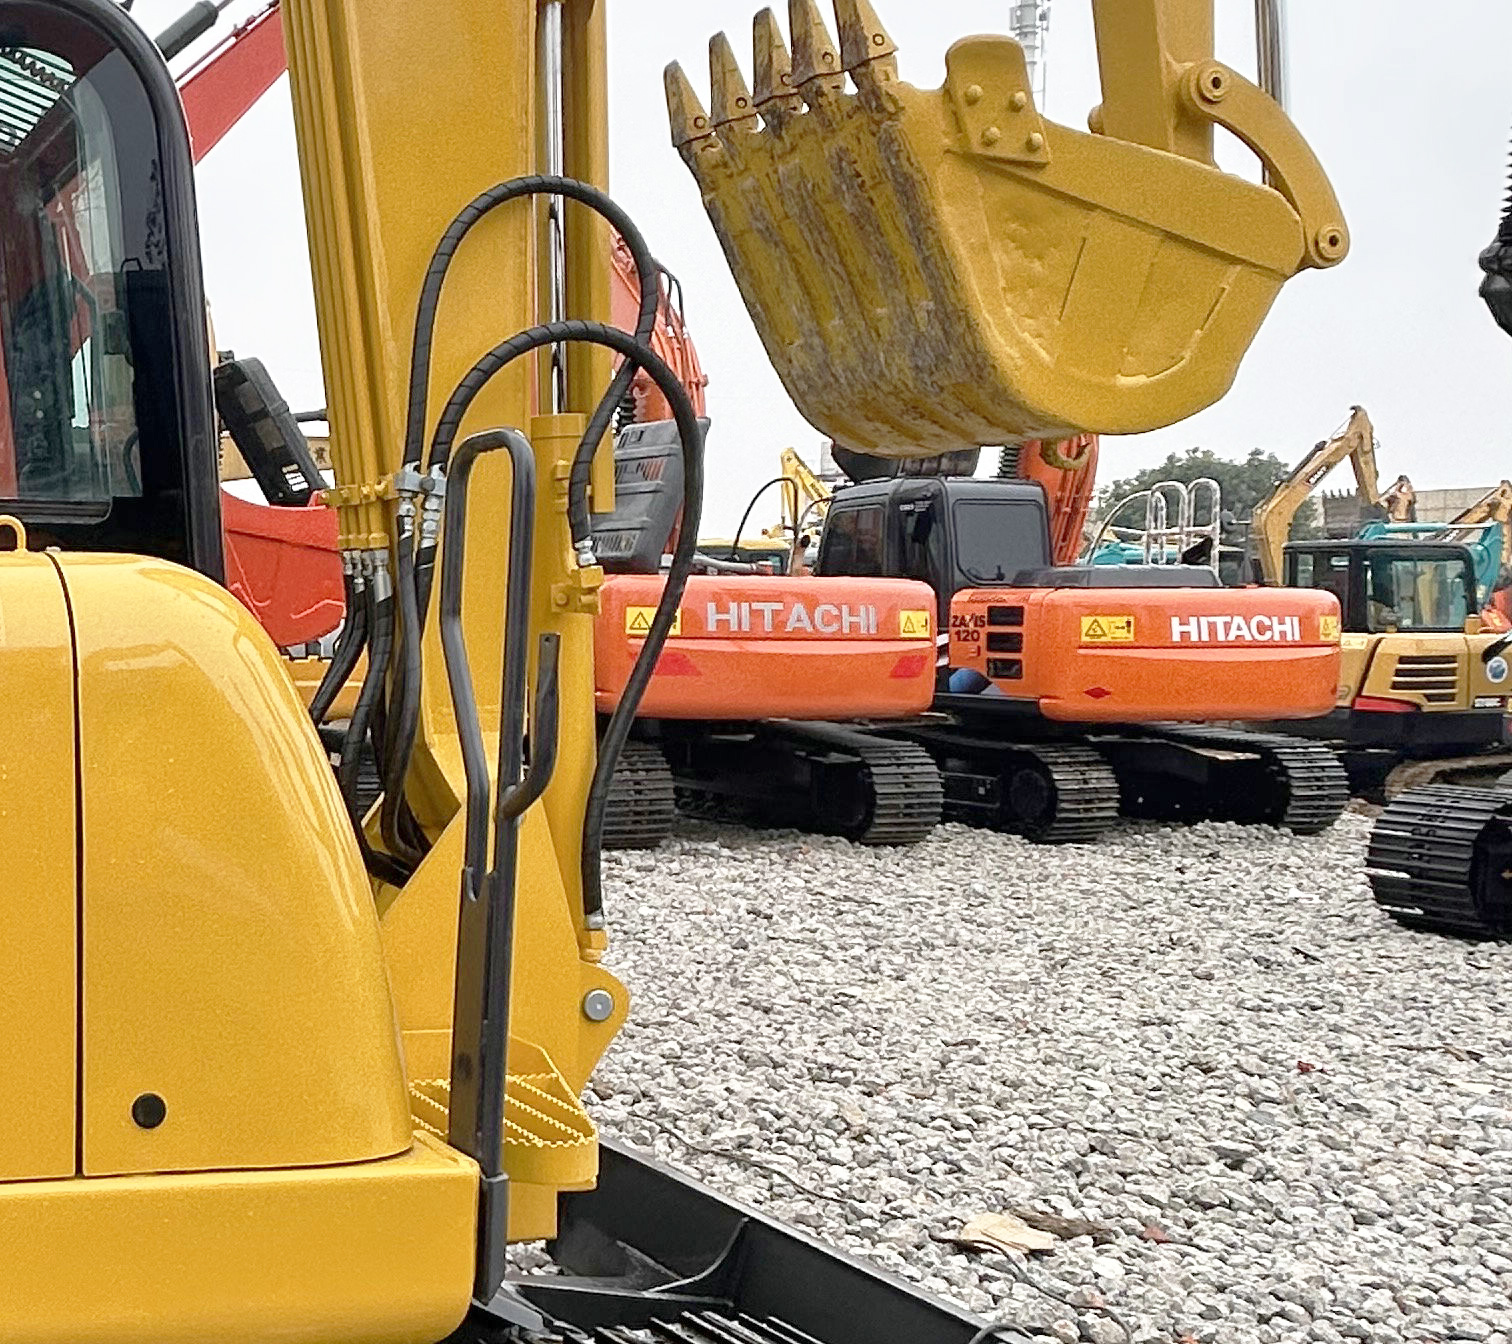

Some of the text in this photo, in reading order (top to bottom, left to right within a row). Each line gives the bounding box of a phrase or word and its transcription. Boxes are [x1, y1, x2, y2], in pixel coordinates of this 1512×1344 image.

[706, 601, 878, 634] HITACHI
[1170, 614, 1301, 643] HITACHI
[954, 628, 981, 642] 120
